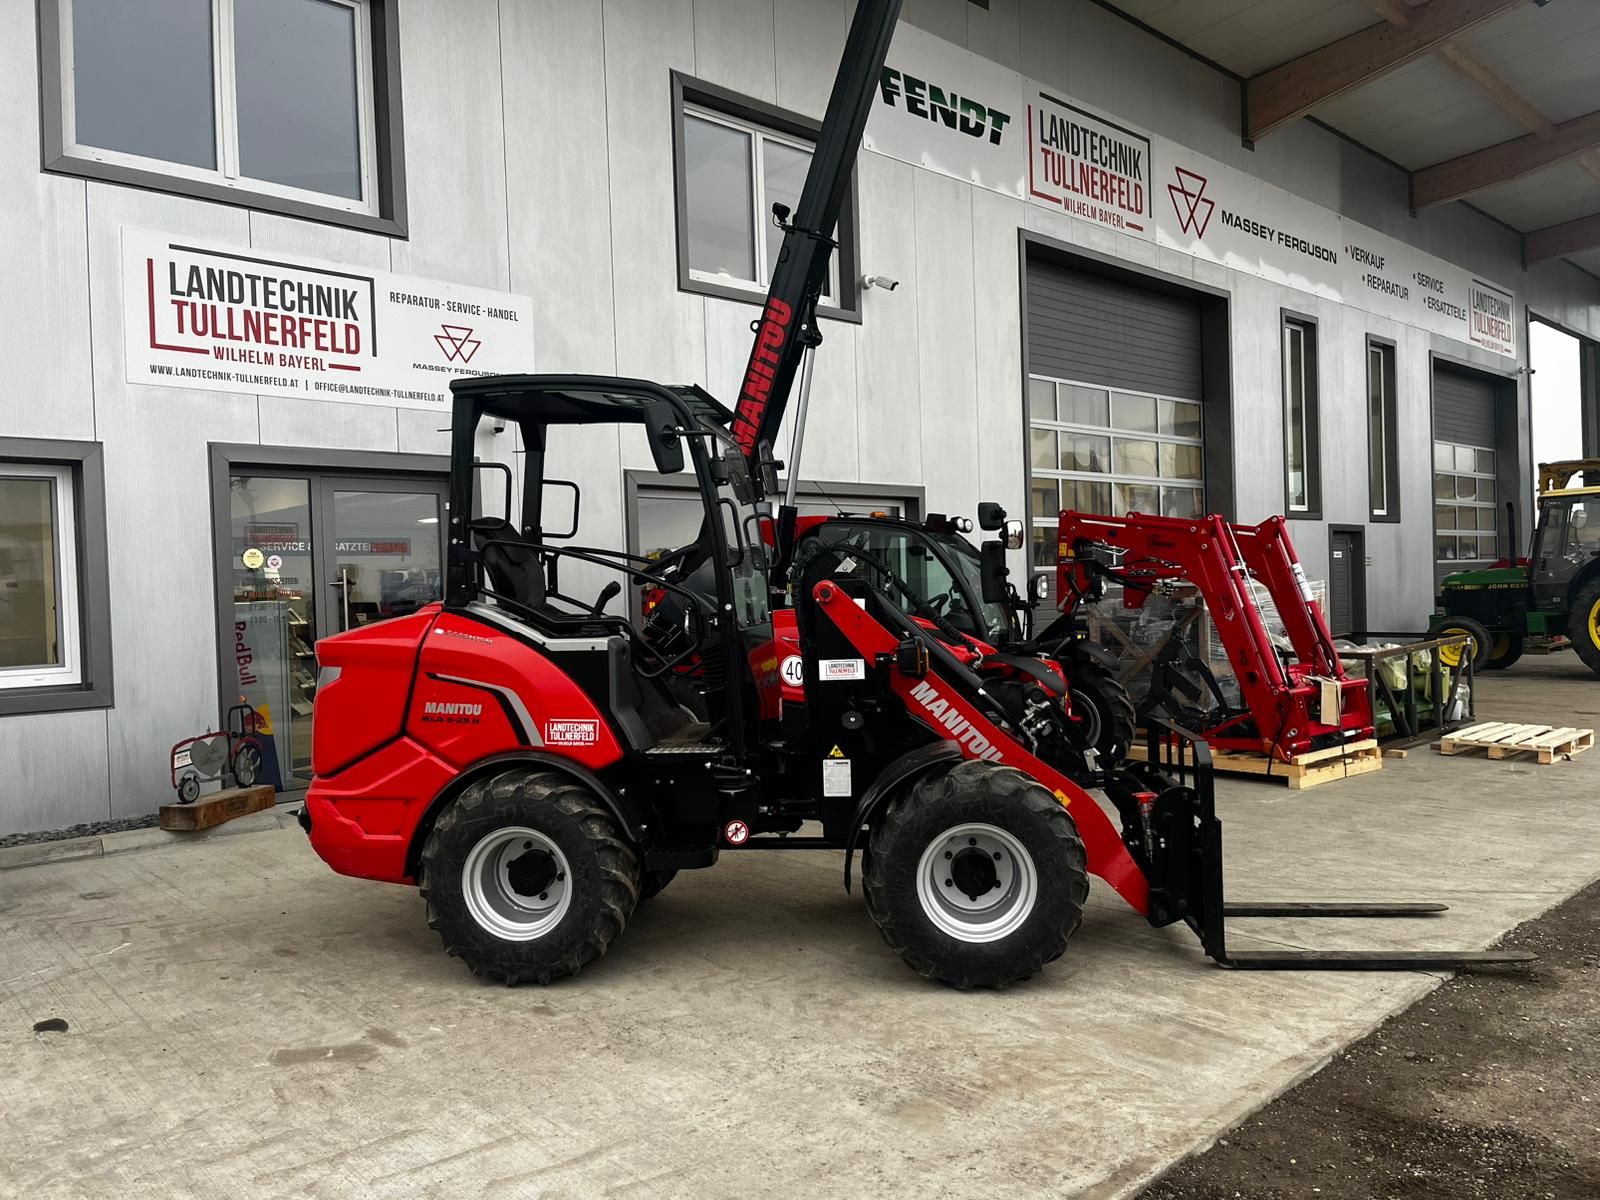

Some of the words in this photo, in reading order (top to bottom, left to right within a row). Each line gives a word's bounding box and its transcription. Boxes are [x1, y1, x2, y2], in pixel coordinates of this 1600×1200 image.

[880, 65, 1011, 146] FENDT
[1040, 109, 1142, 182] LANDTECHNIK
[1041, 147, 1143, 215] TULLNERFELD
[1063, 197, 1097, 220] WILHELM
[1099, 208, 1125, 229] BAYERL
[1221, 210, 1275, 242] MASSEY
[1278, 231, 1337, 264] FERGUSON
[1350, 245, 1385, 270] VERKAUF
[169, 261, 359, 321] LANDTECHNIK
[1367, 274, 1409, 300] REPARATUR
[1417, 272, 1444, 294] SERVICE
[389, 291, 440, 310] REPARATUR
[446, 300, 481, 316] SERVICE
[487, 307, 519, 322] HANDEL
[1427, 296, 1466, 321] ERSATZTEILE
[1472, 288, 1511, 322] LANDTECHNIK
[170, 299, 361, 355] TULLNERFELD
[1473, 310, 1511, 343] TULLNERFELD
[213, 345, 274, 366] WILHELM
[279, 353, 326, 371] BAYERL
[412, 363, 452, 373] MASSEY
[149, 364, 299, 388] WWW.LANDTECHNIK-TULLNERFELD.AT
[733, 296, 792, 457] MANITOU
[259, 541, 305, 551] SERVICE
[786, 660, 803, 681] 40
[424, 702, 482, 716] MANITOU
[909, 680, 1004, 762] MANITOU
[549, 722, 595, 732] LANDTECHNIK
[549, 731, 595, 741] TULLNERFELD
